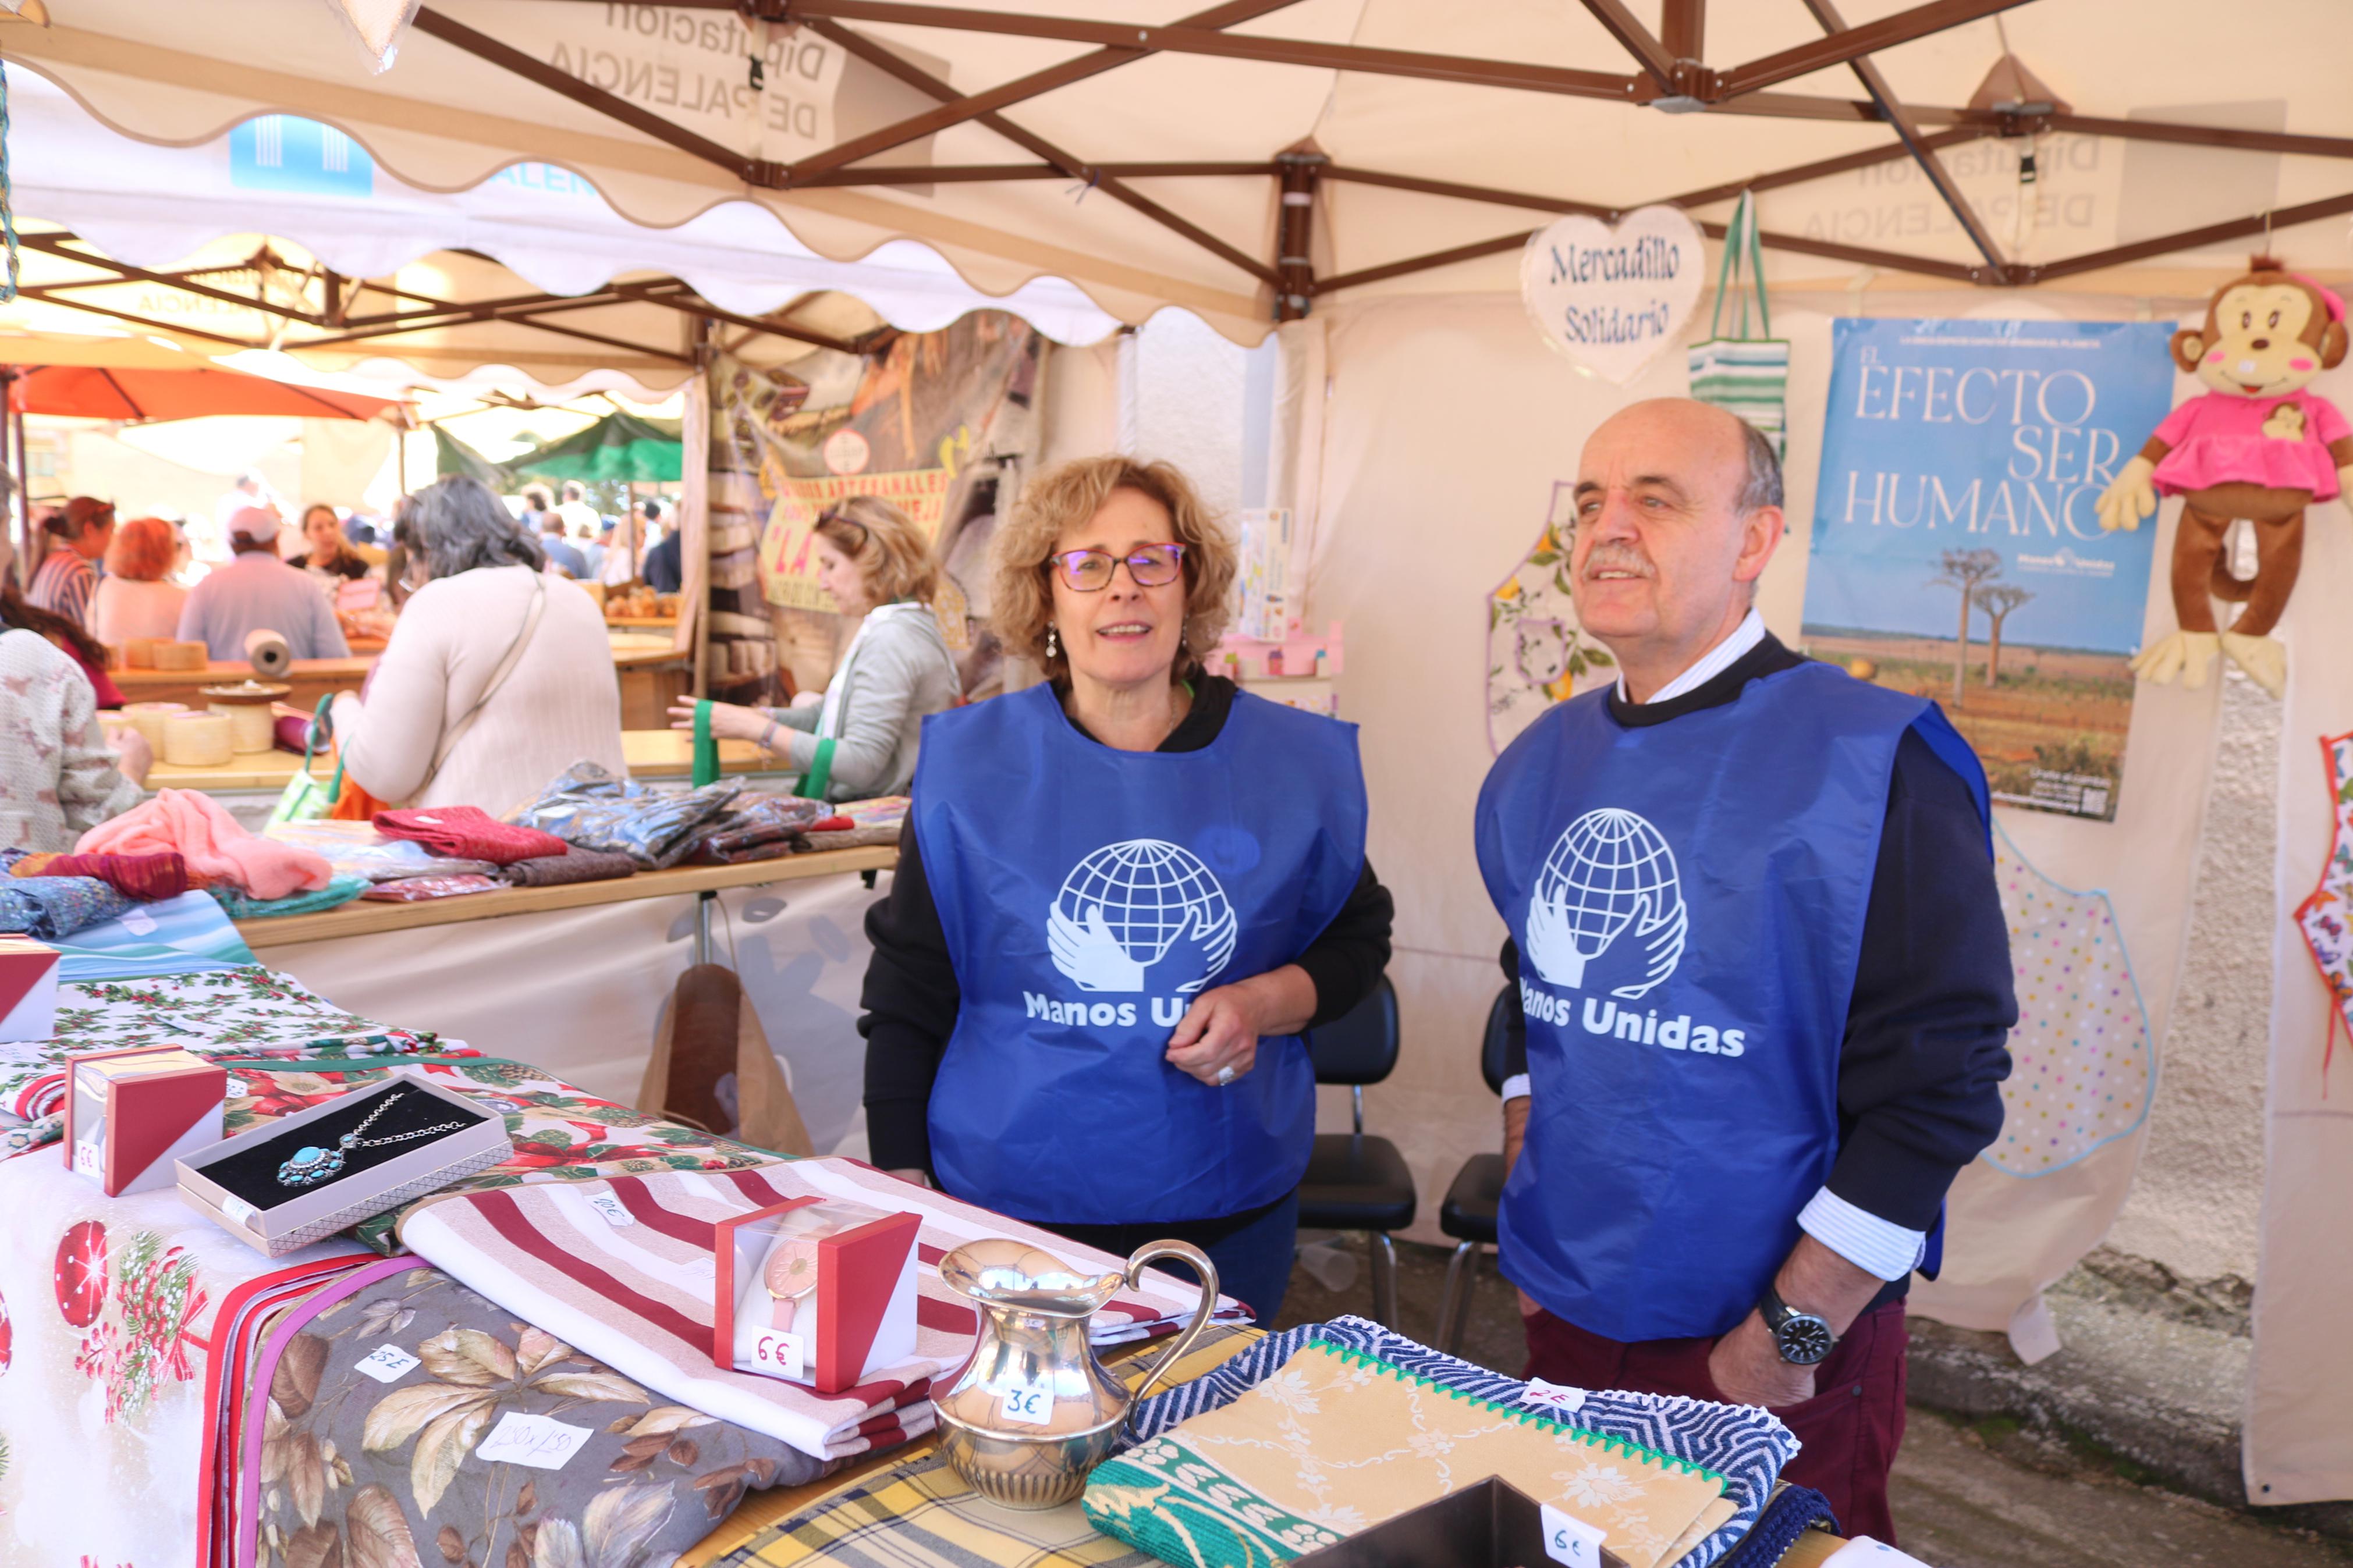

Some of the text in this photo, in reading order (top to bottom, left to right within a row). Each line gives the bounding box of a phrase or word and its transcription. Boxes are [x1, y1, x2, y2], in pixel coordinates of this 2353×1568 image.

[1550, 234, 1680, 284] Mercadillo
[1565, 299, 1669, 343] Solidario
[1860, 346, 1880, 364] EL
[1855, 365, 2096, 428] EFECTO
[2007, 424, 2120, 483] SER
[1844, 470, 2113, 542] HUMANO
[1023, 991, 1191, 1027] Manos U
[1582, 997, 1745, 1058] Unidas
